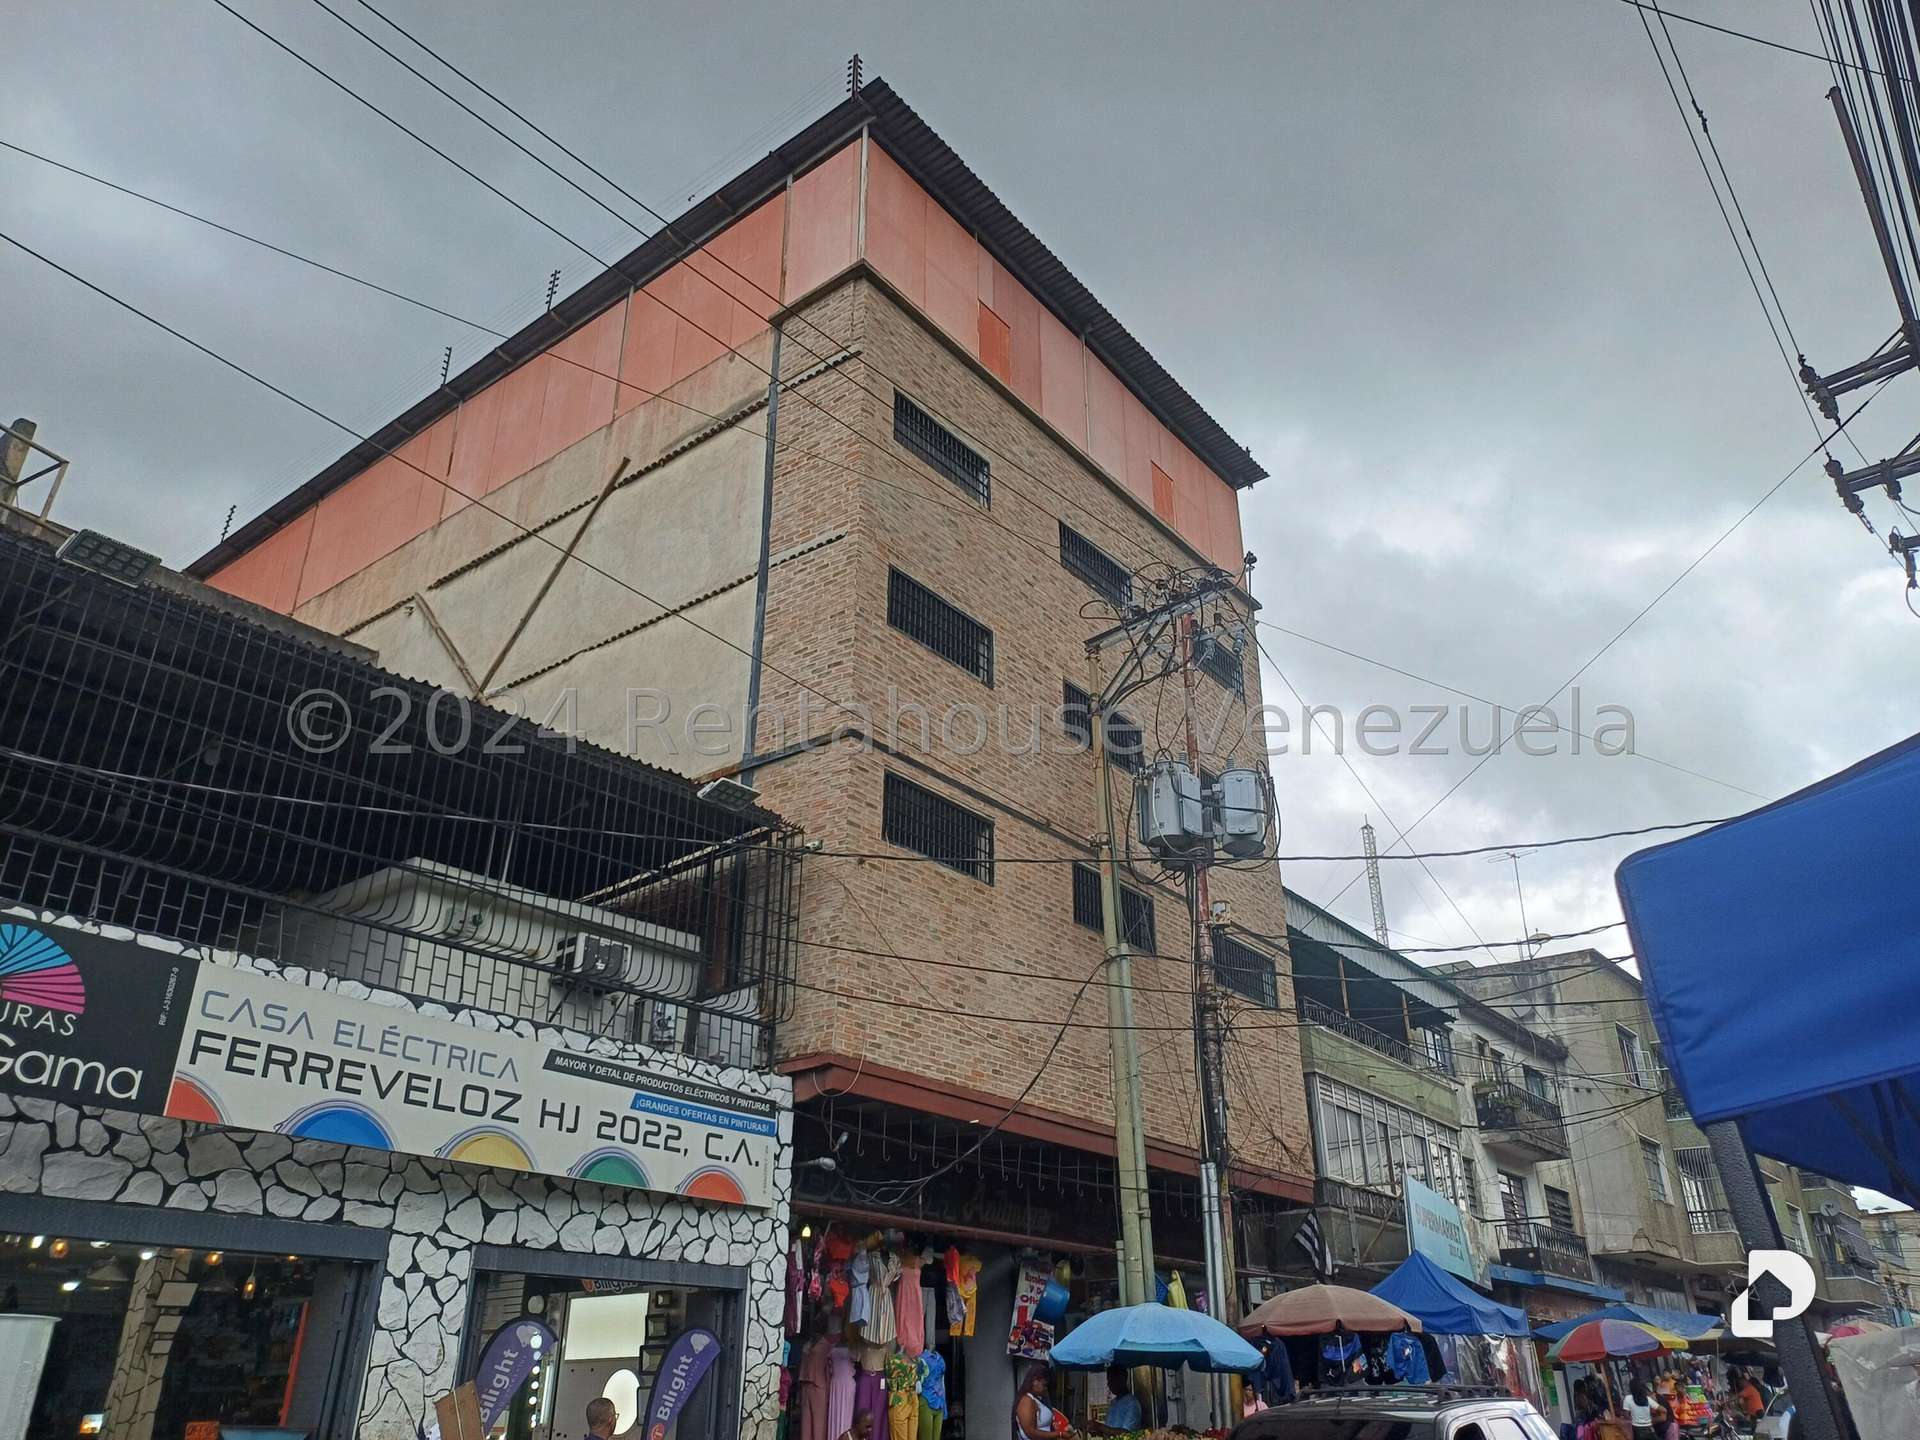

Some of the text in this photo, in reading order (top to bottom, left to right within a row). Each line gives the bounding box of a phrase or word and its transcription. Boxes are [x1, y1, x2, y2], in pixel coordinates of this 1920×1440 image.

[200, 990, 519, 1082] CASA ELÉCTRICA
[188, 1029, 760, 1168] FERREVELOZ HJ 2022, C.A.
[555, 1056, 770, 1113] MAYOR Y DETAL DE PRODUCTOS ELÉCTRICOS Y PINTURAS
[636, 1098, 769, 1133] ¡GRANDES OFERTAS EN PINTURAS!
[656, 1354, 694, 1421] Bilight
